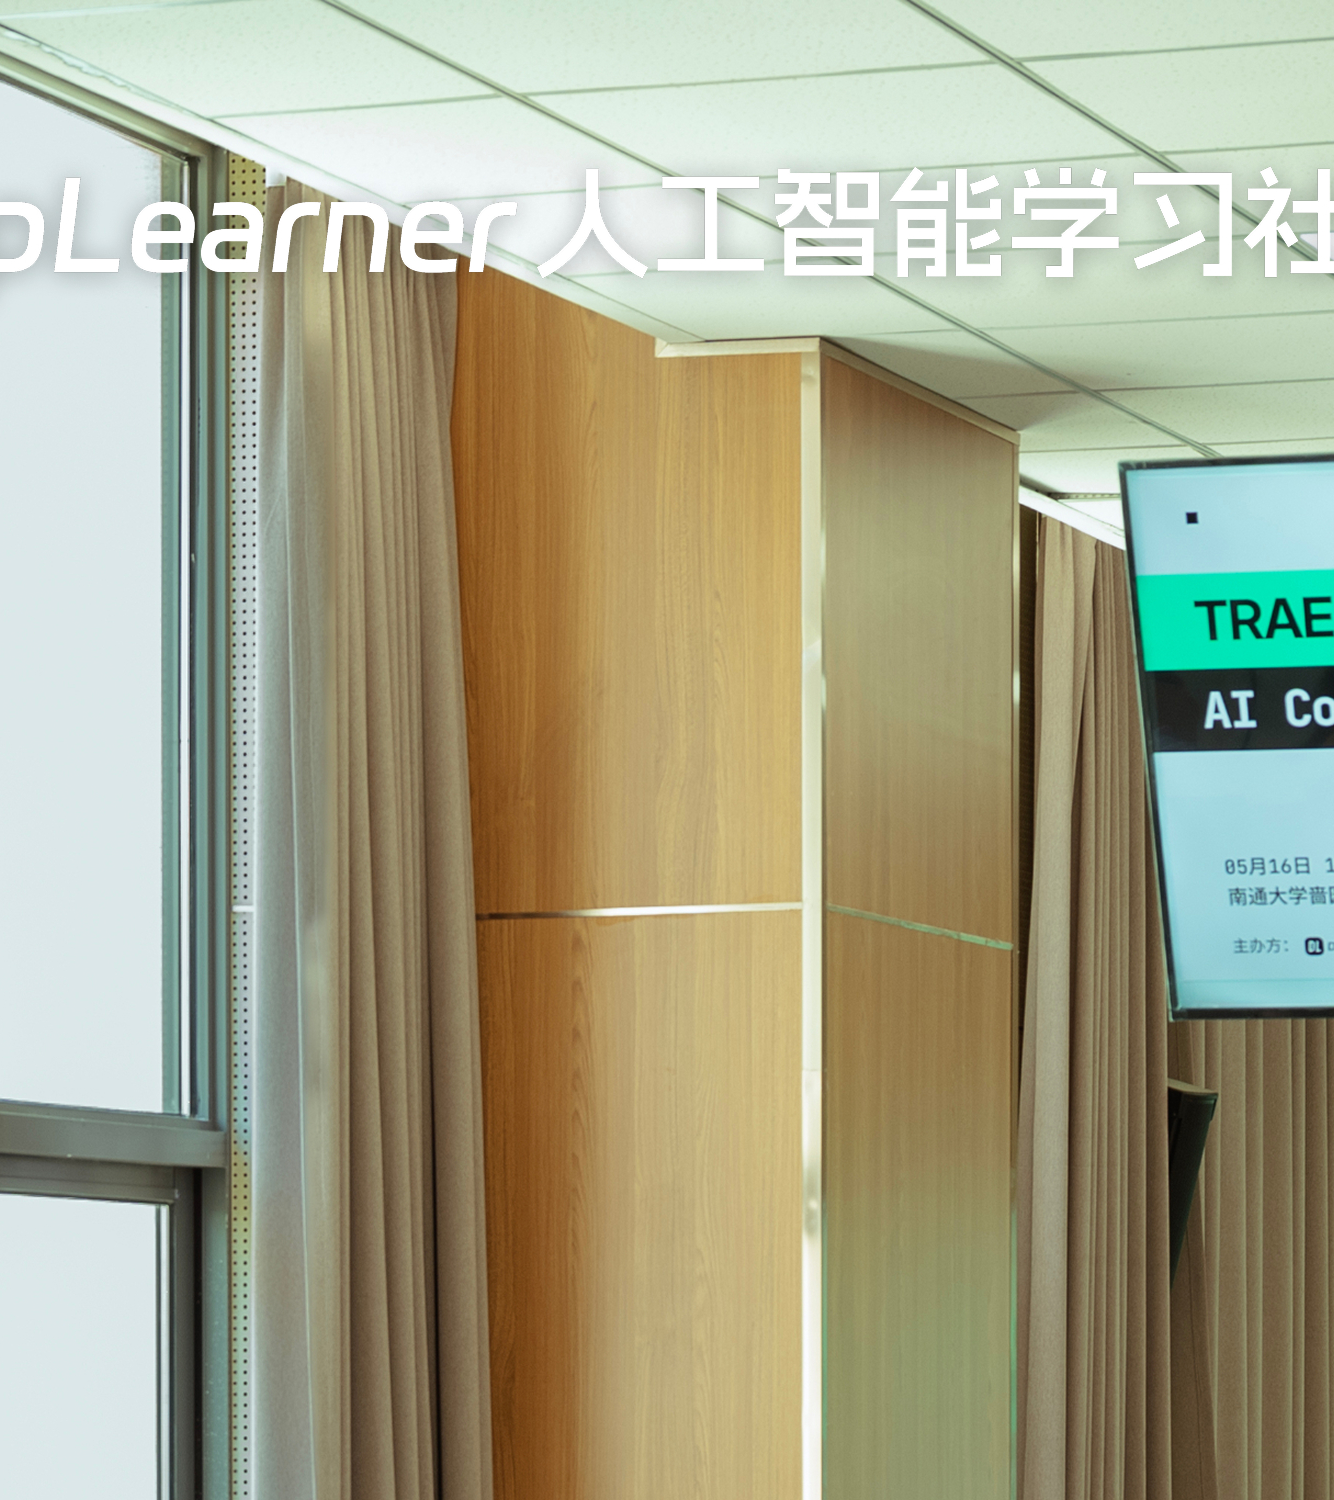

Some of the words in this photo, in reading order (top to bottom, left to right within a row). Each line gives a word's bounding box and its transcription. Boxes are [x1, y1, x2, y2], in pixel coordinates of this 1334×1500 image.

[1193, 596, 1334, 641] TRAE
[1204, 690, 1257, 730] AI
[1224, 856, 1311, 876] 05月16日
